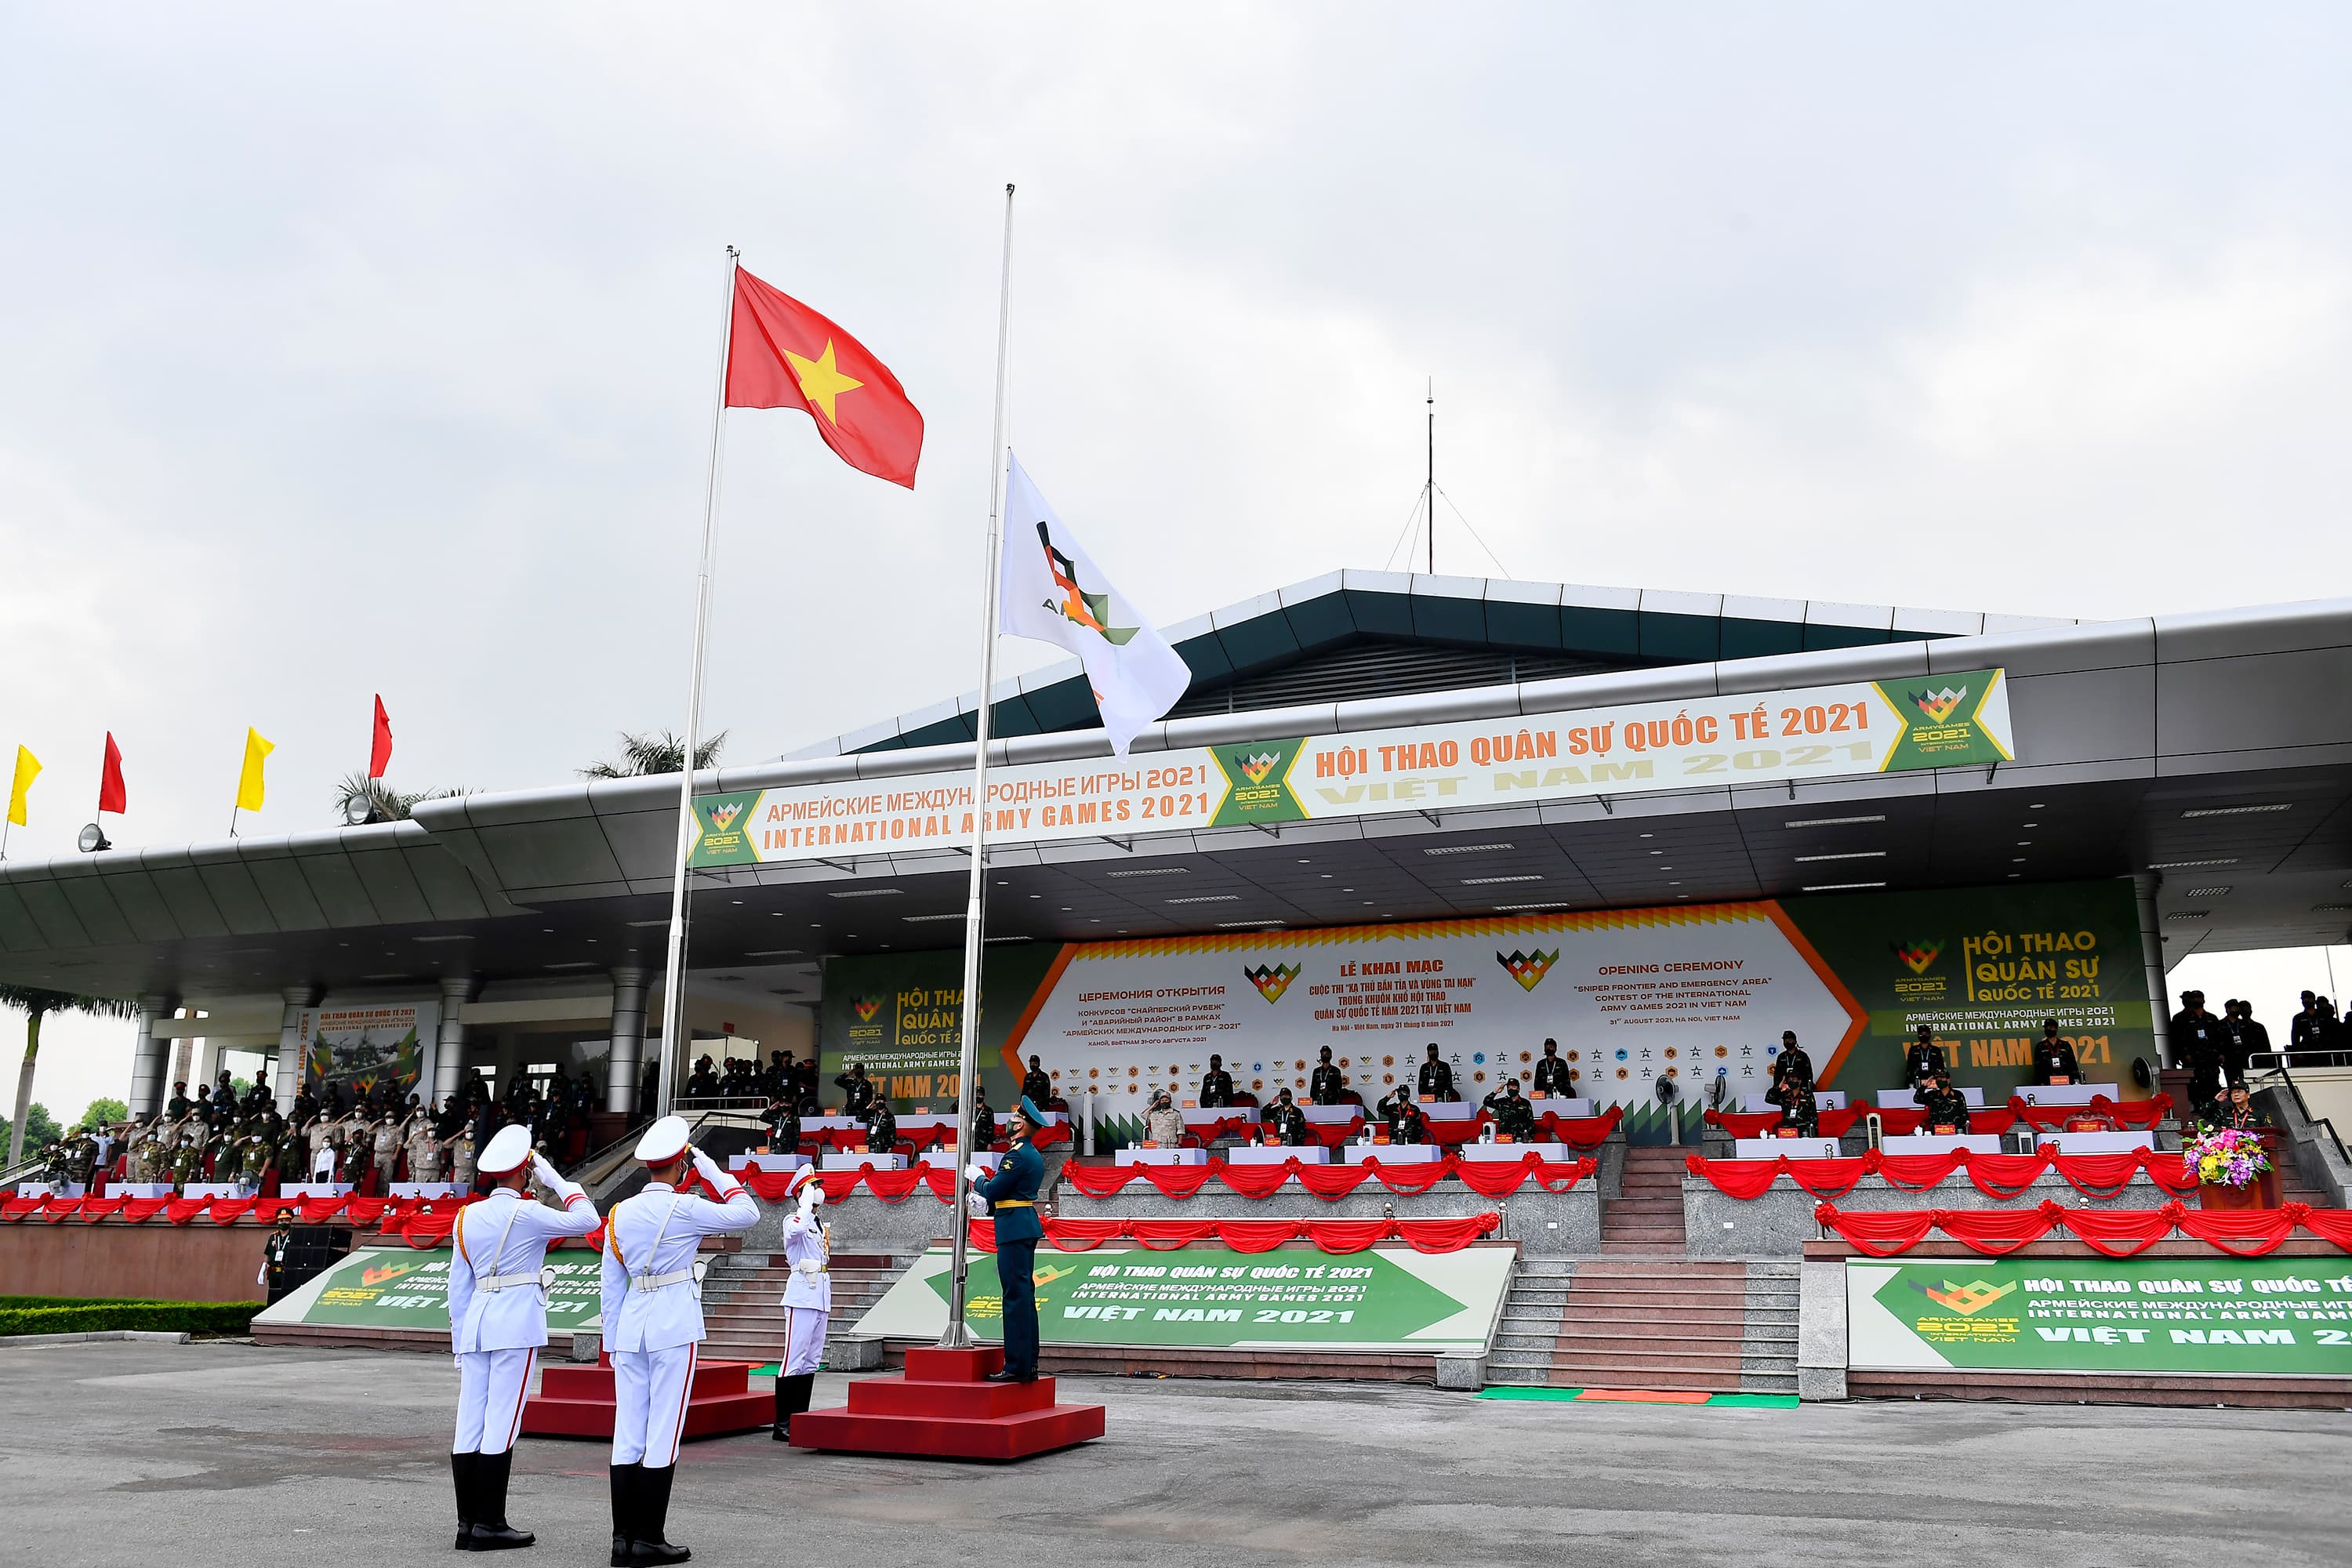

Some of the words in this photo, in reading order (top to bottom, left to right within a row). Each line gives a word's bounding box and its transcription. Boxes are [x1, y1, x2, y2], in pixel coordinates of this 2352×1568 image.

[1912, 722, 1970, 731] ARMYGAMES
[1316, 746, 1368, 781] HỘI
[1377, 740, 1458, 772] THAO
[1470, 728, 1556, 766] QUÂN
[1568, 721, 1614, 758] SỰ
[1624, 709, 1719, 752] QUỐC
[1729, 702, 1769, 741] TẾ
[1780, 702, 1868, 736] 2021
[1912, 728, 1971, 742] 2021
[1315, 776, 1468, 804] VIỆT
[1494, 759, 1653, 790] NAM
[1682, 741, 1873, 776] 2021
[767, 795, 883, 822] АРМЕЙСКИЕ
[886, 777, 1076, 812] МЕЖДУНРОДНЫЕ
[1081, 771, 1140, 795] ИГРЫ
[1147, 764, 1206, 789] 2021
[1236, 789, 1280, 800] 2021
[764, 815, 952, 850] INTERNATIONAL
[1042, 800, 1131, 827] GAMES
[1142, 792, 1207, 818] 2021
[704, 837, 740, 846] 2021
[1962, 931, 2012, 960] HỘI
[2020, 931, 2096, 953] THAO
[1341, 960, 1357, 978] LỄ
[1362, 961, 1400, 976] KHAI
[1406, 959, 1443, 975] MẠC
[1599, 965, 1659, 975] OPENING
[1664, 960, 1744, 972] CEREMONY
[1976, 956, 2056, 983] QUÂN
[2065, 955, 2100, 983] SỰ
[1331, 984, 1344, 994] THI
[1681, 979, 1739, 988] EMERGENCY
[1894, 982, 1947, 993] 2021
[1079, 989, 1152, 1003] ЦЕРЕМОНИЯ
[1156, 985, 1225, 998] ОТКРЫТИЯ
[1338, 995, 1363, 1006] TRONG
[1426, 992, 1446, 1002] THAO
[1675, 989, 1751, 998] INTERNATIONAL
[1977, 982, 2031, 1002] QUỐC
[2036, 982, 2056, 1000] TẾ
[2060, 984, 2100, 1000] 2021
[1078, 1008, 1126, 1017] КОНКУРСОВ
[1401, 1005, 1419, 1015] 2021
[1454, 1003, 1471, 1013] NAM
[1905, 1010, 1963, 1022] АРМЕЙСКИЕ
[1965, 1008, 2056, 1021] МЕЖДУНАРОДНЫЕ
[2056, 1007, 2085, 1016] ИГРЫ
[2087, 1007, 2114, 1015] 2021
[902, 1008, 954, 1029] QUÂN
[1185, 1014, 1221, 1022] РАМКАХ
[2004, 1020, 2037, 1029] ARMY
[2087, 1018, 2116, 1026] 2021
[902, 1030, 936, 1045] QUỐC
[939, 1029, 953, 1044] TẾ
[1116, 1025, 1193, 1035] МЕЖДУНАРОДНЫХ
[1970, 1038, 2032, 1067] NAM
[891, 1075, 931, 1098] NAM
[1087, 1265, 1121, 1279] HỘI
[1123, 1265, 1167, 1278] THAO
[1169, 1265, 1218, 1279] QUÂN
[1219, 1265, 1249, 1279] SỰ
[1250, 1264, 1301, 1279] QUỐC
[1304, 1264, 1327, 1279] TẾ
[1327, 1266, 1374, 1279] 2021
[1077, 1282, 1159, 1291] АРМЕЙСКИЕ
[1158, 1283, 1285, 1294] МЕЖДУНАРОДНЫЕ
[2023, 1278, 2065, 1294] HỘI
[2069, 1279, 2132, 1293] THAO
[2137, 1278, 2204, 1294] QUÂN
[2208, 1278, 2243, 1295] SỰ
[2251, 1276, 2321, 1294] QUỐC
[322, 1291, 378, 1300] 2021
[375, 1294, 441, 1309] VIỆT
[1071, 1291, 1200, 1301] INTERNATIONAL
[1203, 1293, 1254, 1301] ARMY
[1321, 1294, 1364, 1302] 2021
[2028, 1298, 2140, 1308] АРМЕЙСКИЕ
[2141, 1300, 2321, 1310] МЕЖДУНАРОДНЫЕ
[1063, 1305, 1146, 1322] VIỆT
[1152, 1308, 1244, 1323] NAM
[1252, 1308, 1356, 1323] 2021
[2028, 1309, 2213, 1319] INTERNATIONAL
[2220, 1311, 2286, 1319] ARMY
[1917, 1322, 2020, 1333] 2021
[2034, 1325, 2151, 1345] VIỆT
[2168, 1329, 2296, 1345] NAM
